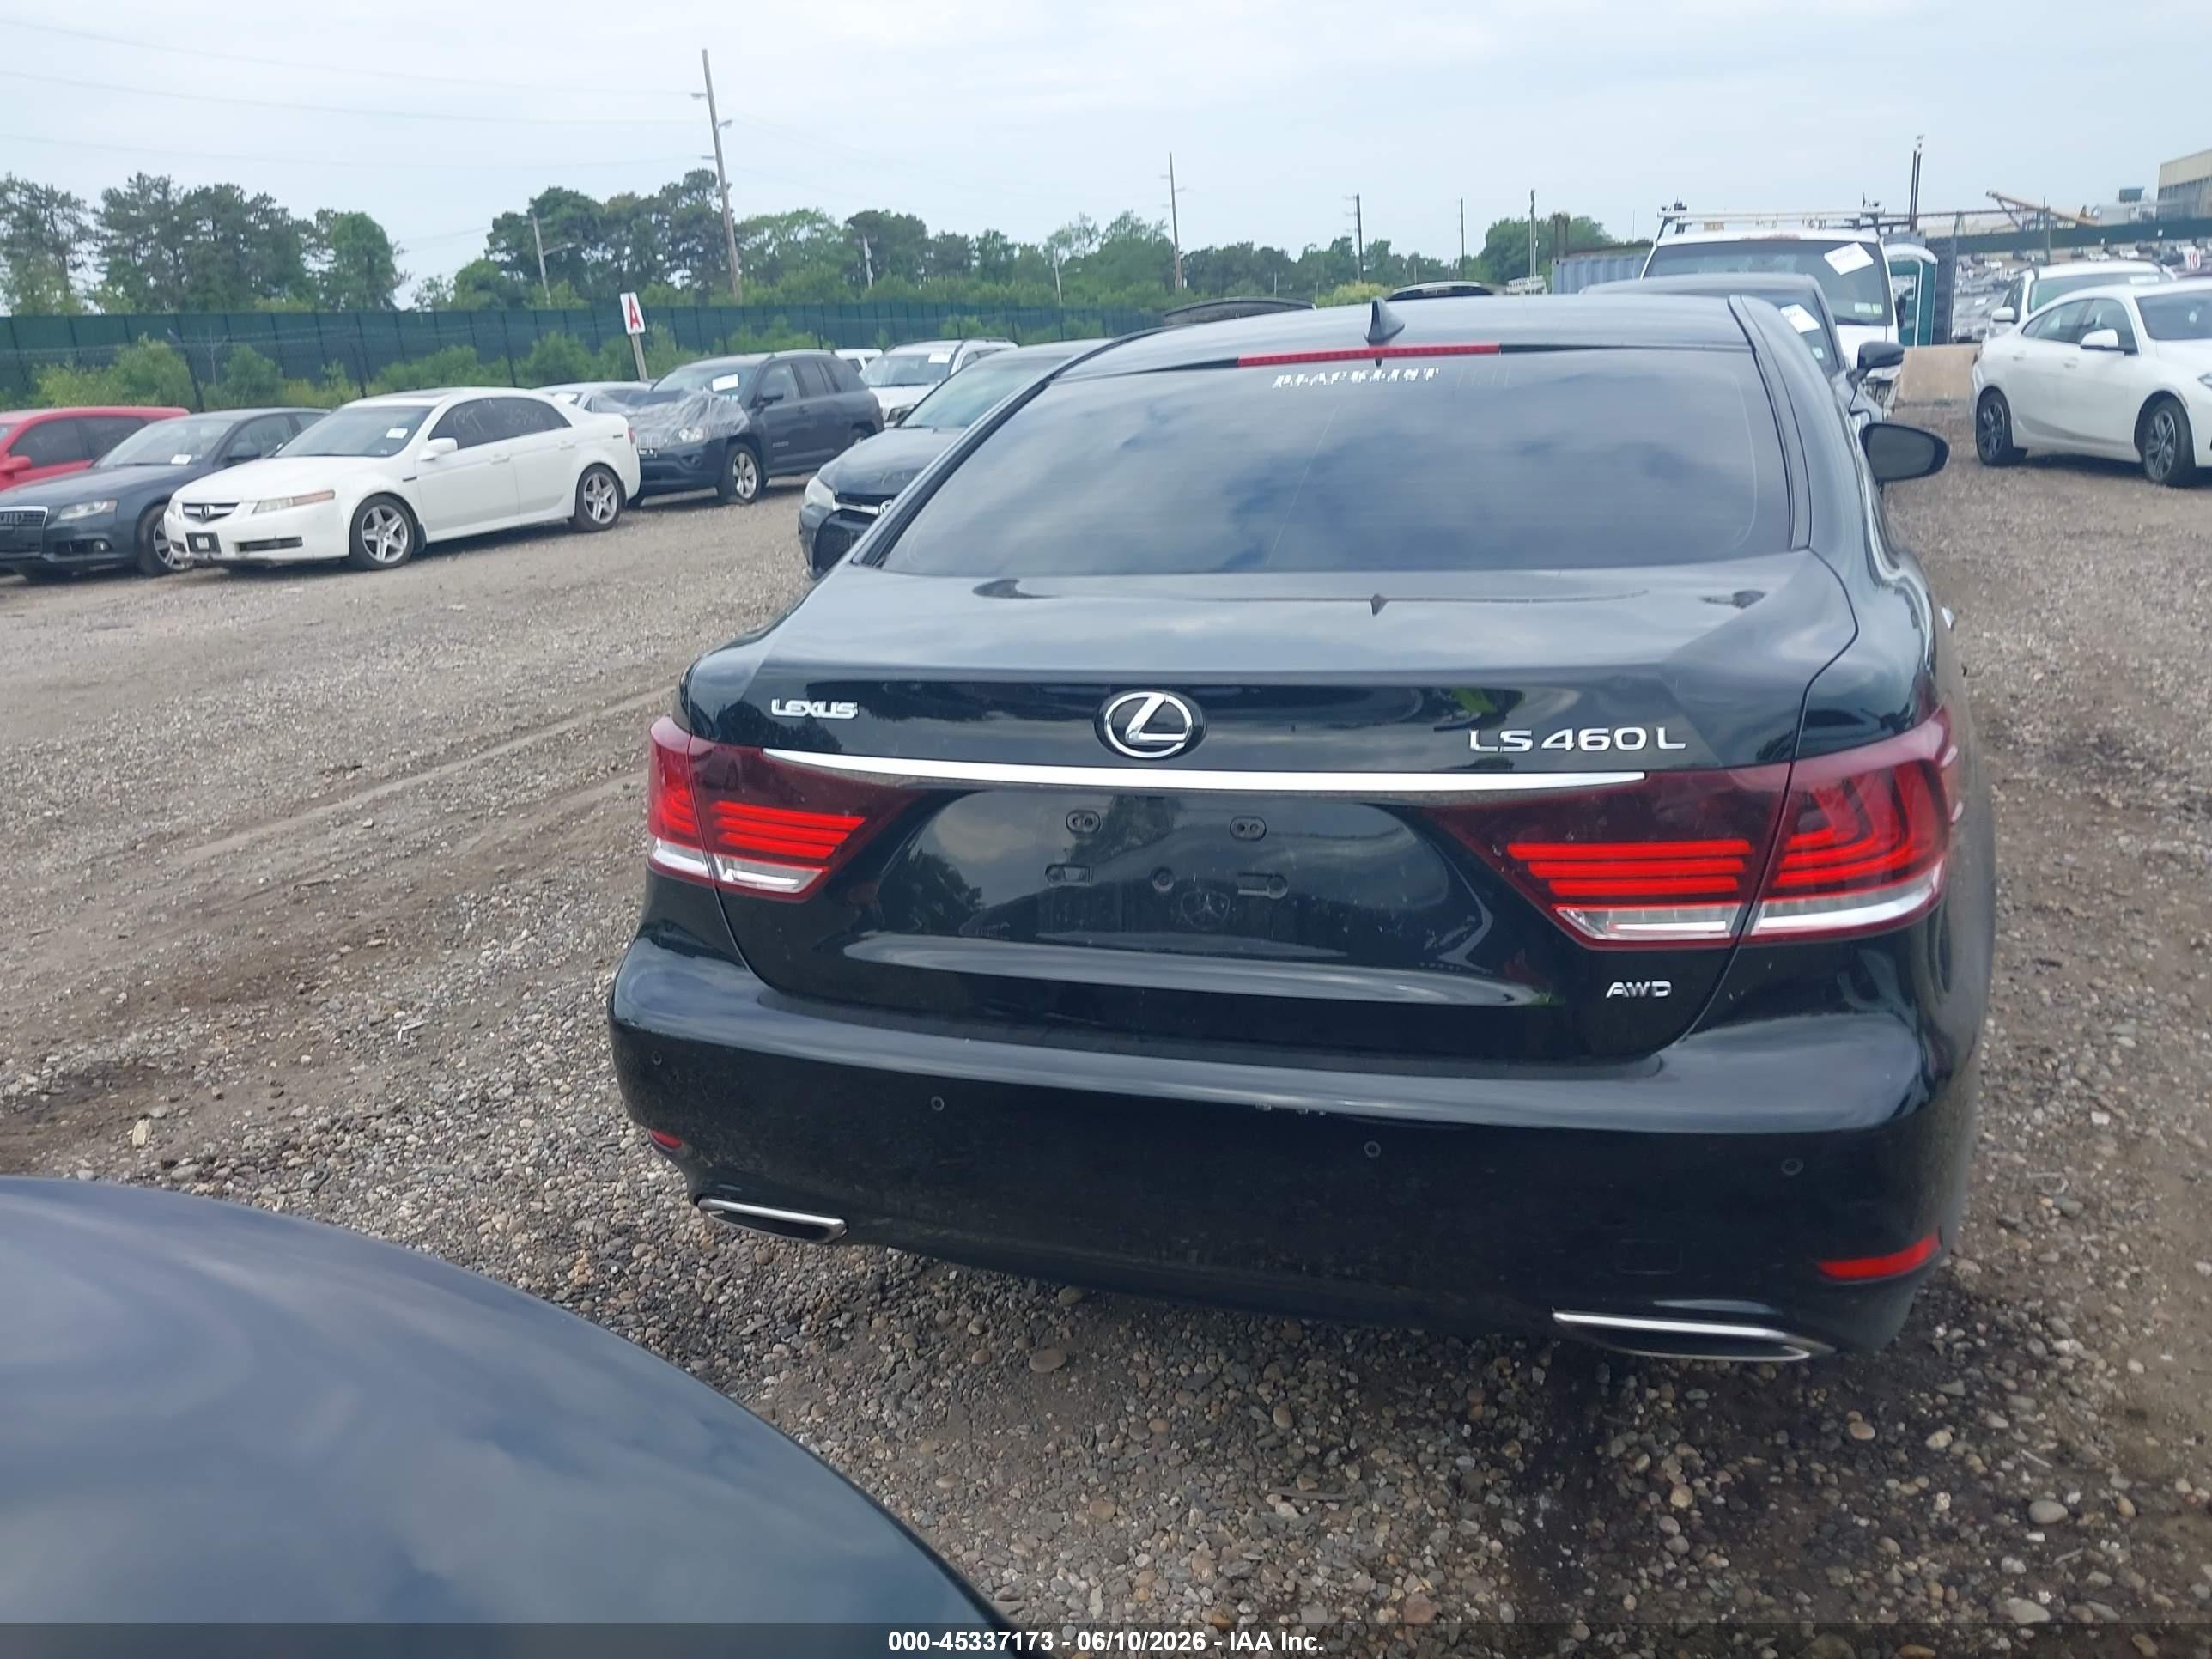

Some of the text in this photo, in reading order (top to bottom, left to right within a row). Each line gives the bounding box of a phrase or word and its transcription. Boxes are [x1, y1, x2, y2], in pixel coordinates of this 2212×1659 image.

[629, 295, 641, 330] A
[771, 698, 858, 720] LEXUS
[1468, 726, 1687, 752] LS 460 L
[1605, 981, 1672, 998] AWD
